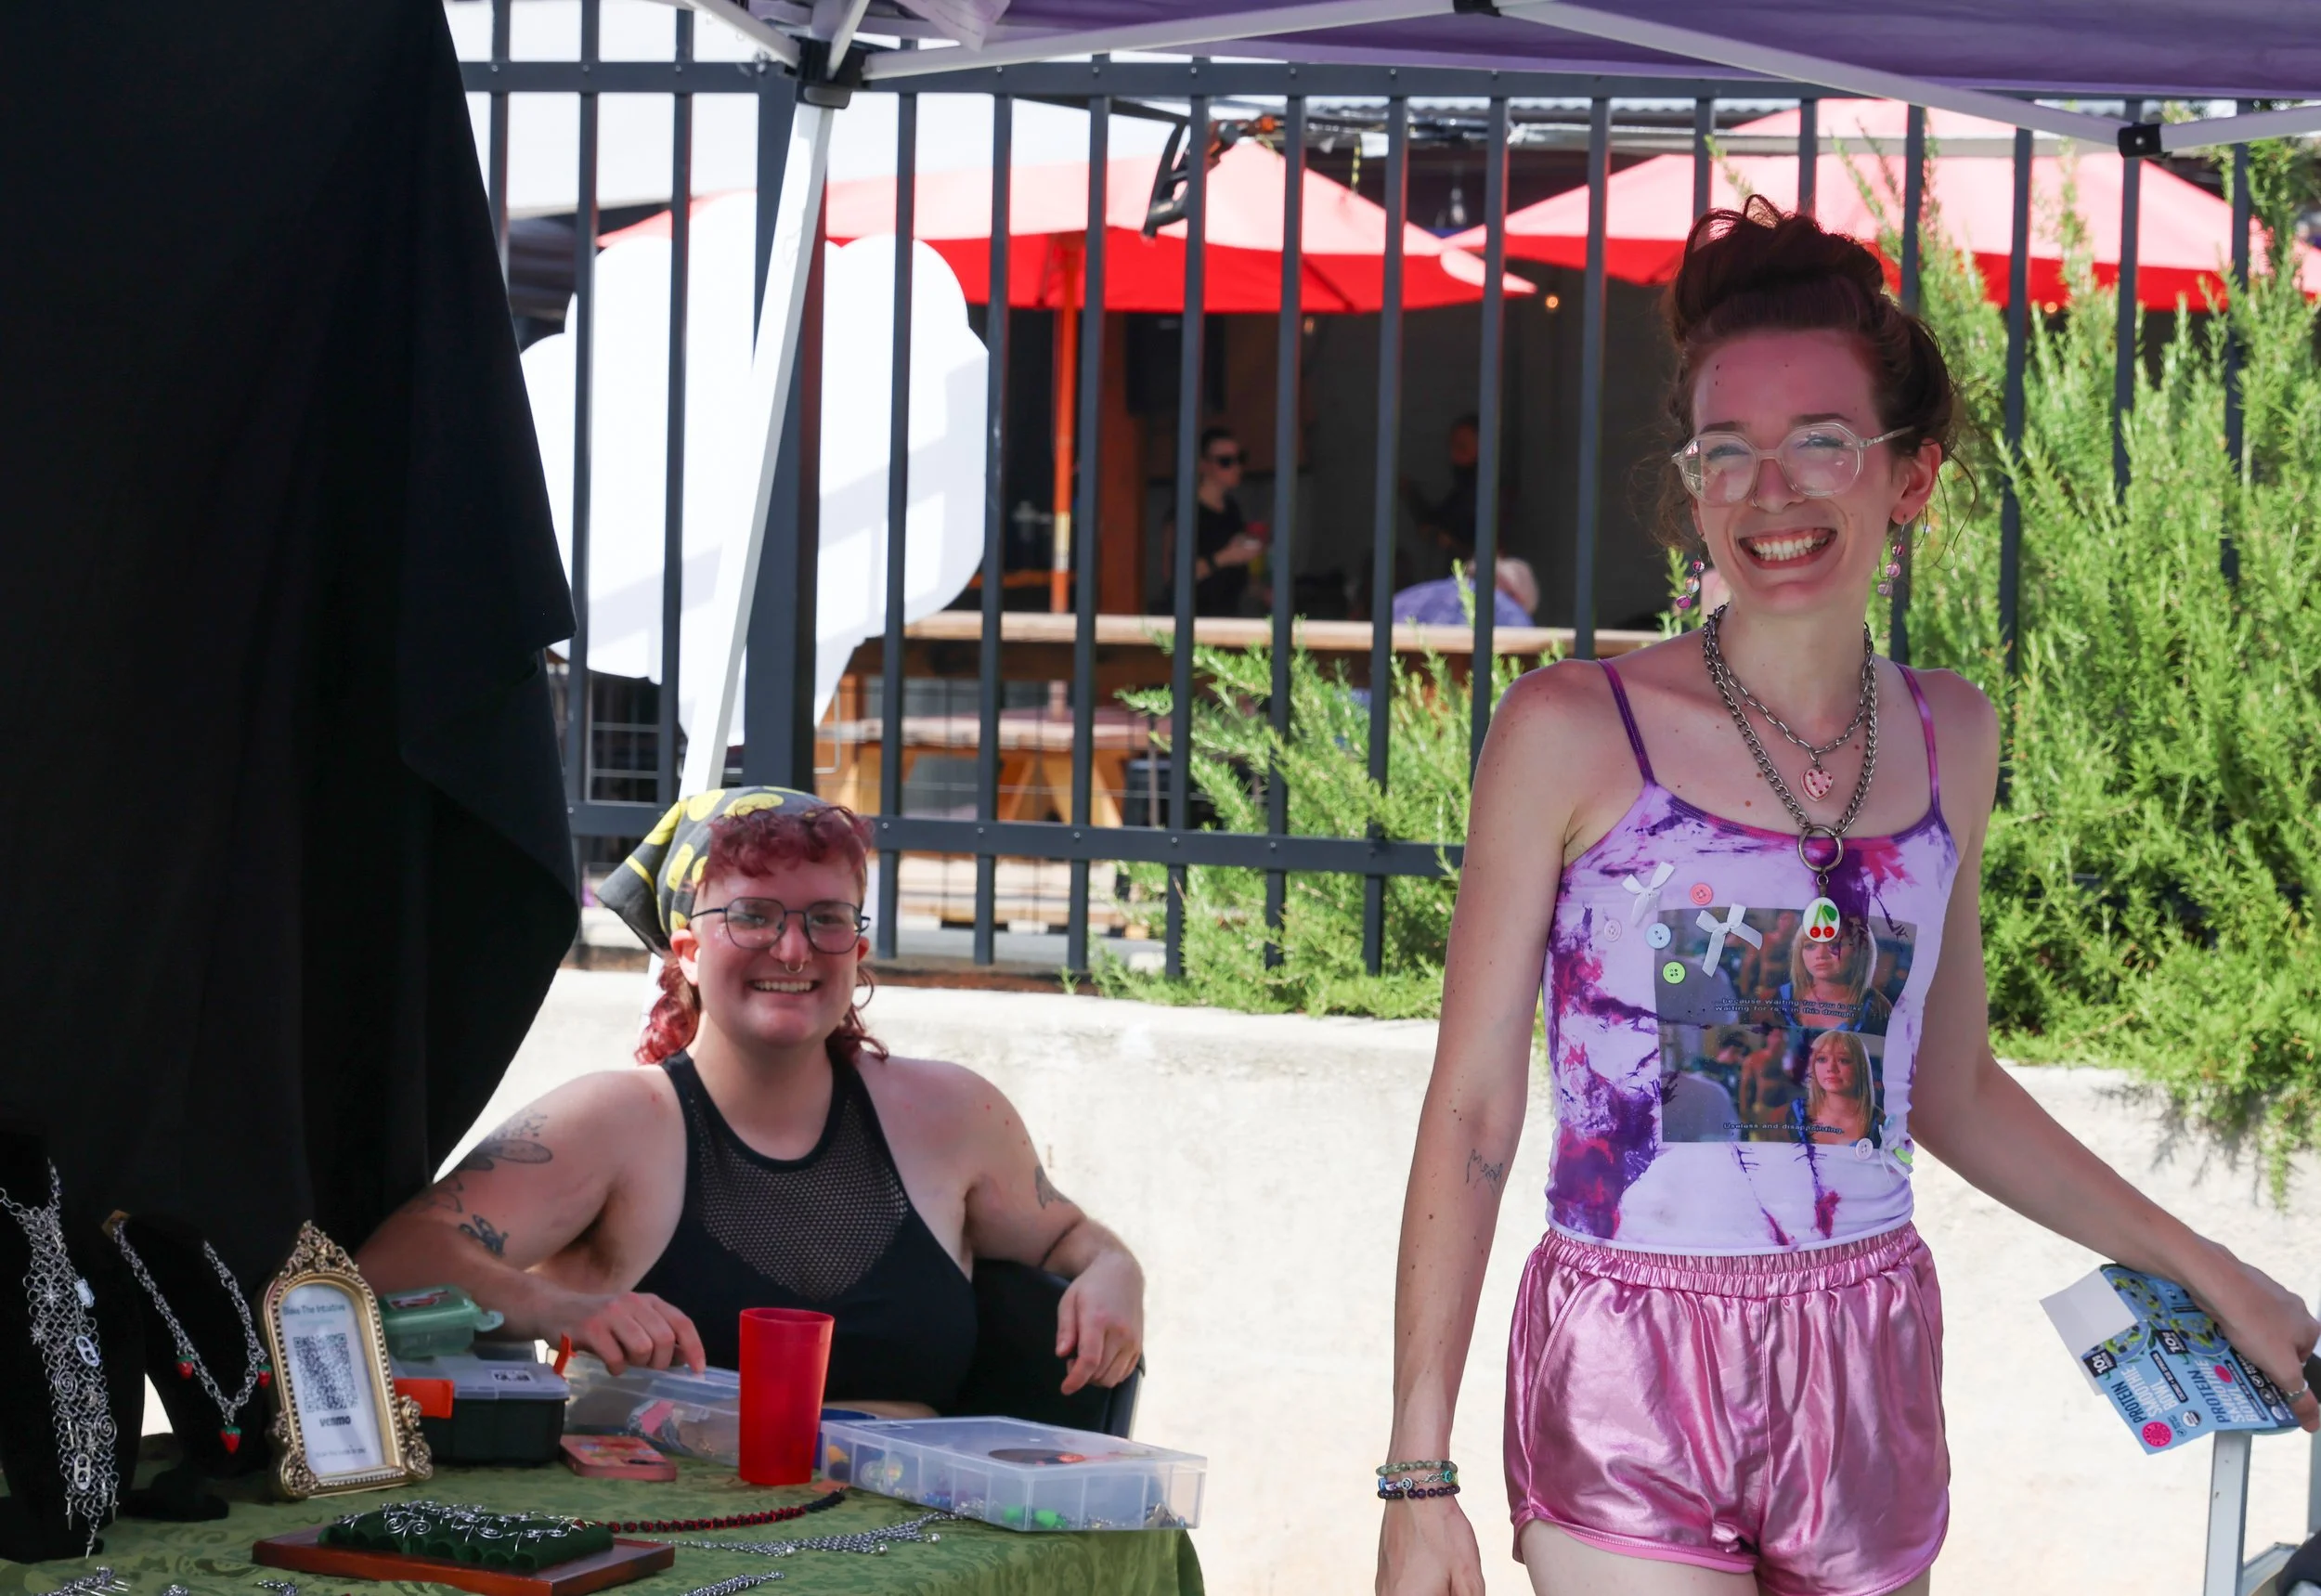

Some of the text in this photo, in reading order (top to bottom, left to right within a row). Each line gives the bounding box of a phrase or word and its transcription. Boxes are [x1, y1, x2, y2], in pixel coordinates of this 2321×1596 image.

[1723, 1122, 1758, 1130] Useless
[1762, 1122, 1779, 1130] and
[2092, 1355, 2107, 1374] 10g
[2111, 1382, 2147, 1423] PROTEIN
[2120, 1365, 2163, 1418] SMOOTHIE
[2150, 1378, 2179, 1411] BOWL
[2187, 1369, 2230, 1422] PROTEIN
[2194, 1359, 2245, 1422] SMOOTHIE
[2226, 1387, 2259, 1422] BOWL
[318, 1415, 352, 1427] venmo
